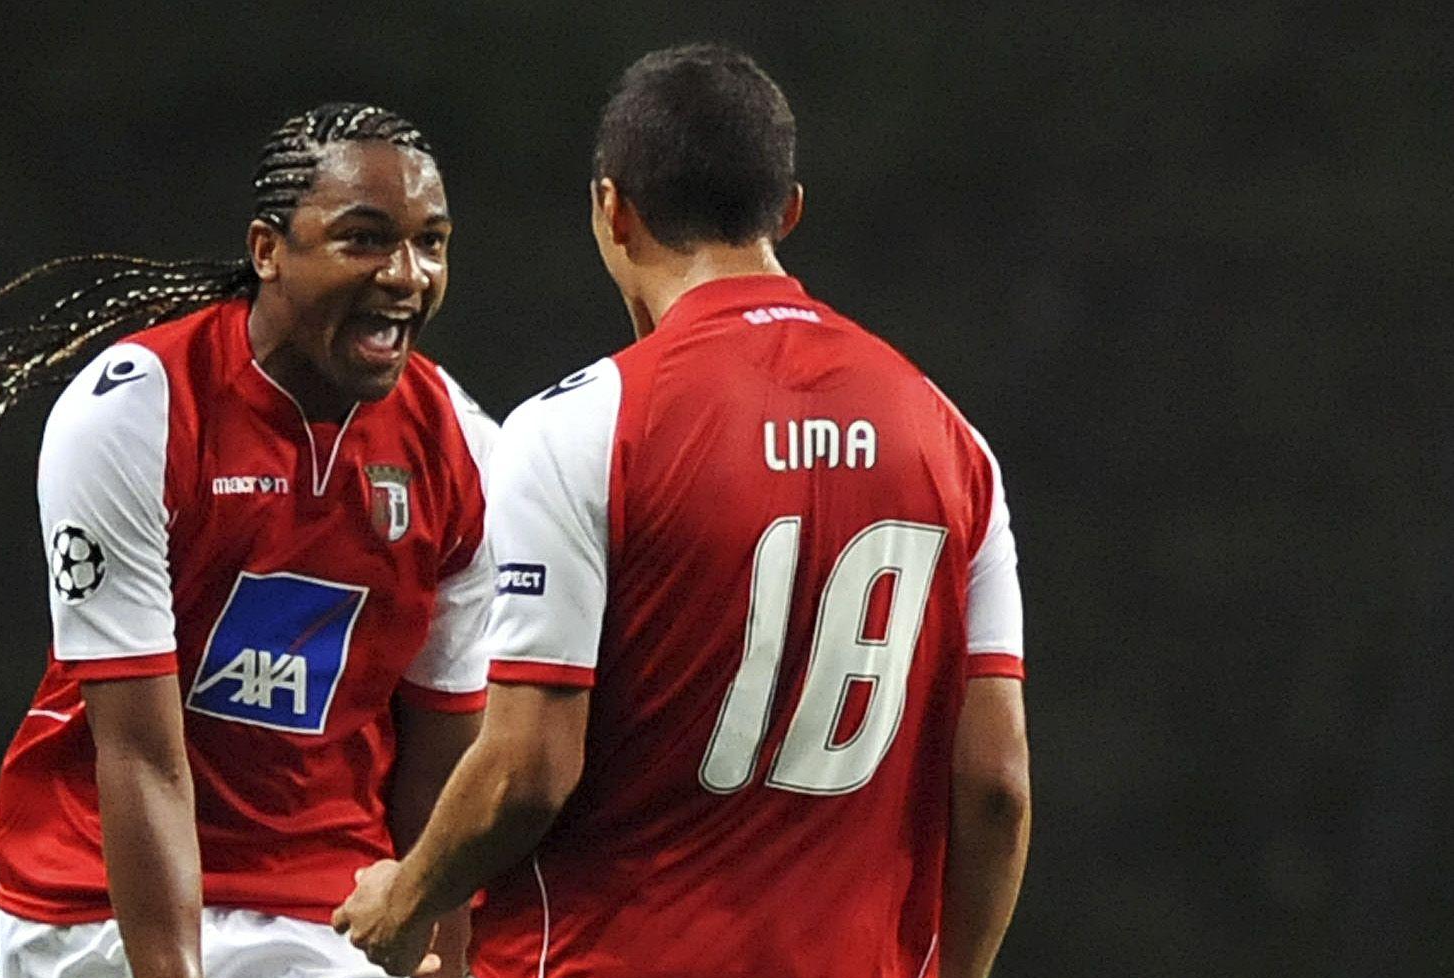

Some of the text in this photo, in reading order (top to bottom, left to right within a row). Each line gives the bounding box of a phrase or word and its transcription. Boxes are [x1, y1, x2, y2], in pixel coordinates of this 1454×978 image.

[763, 418, 877, 471] LIMA
[192, 647, 306, 715] AXA
[698, 515, 949, 796] 18
